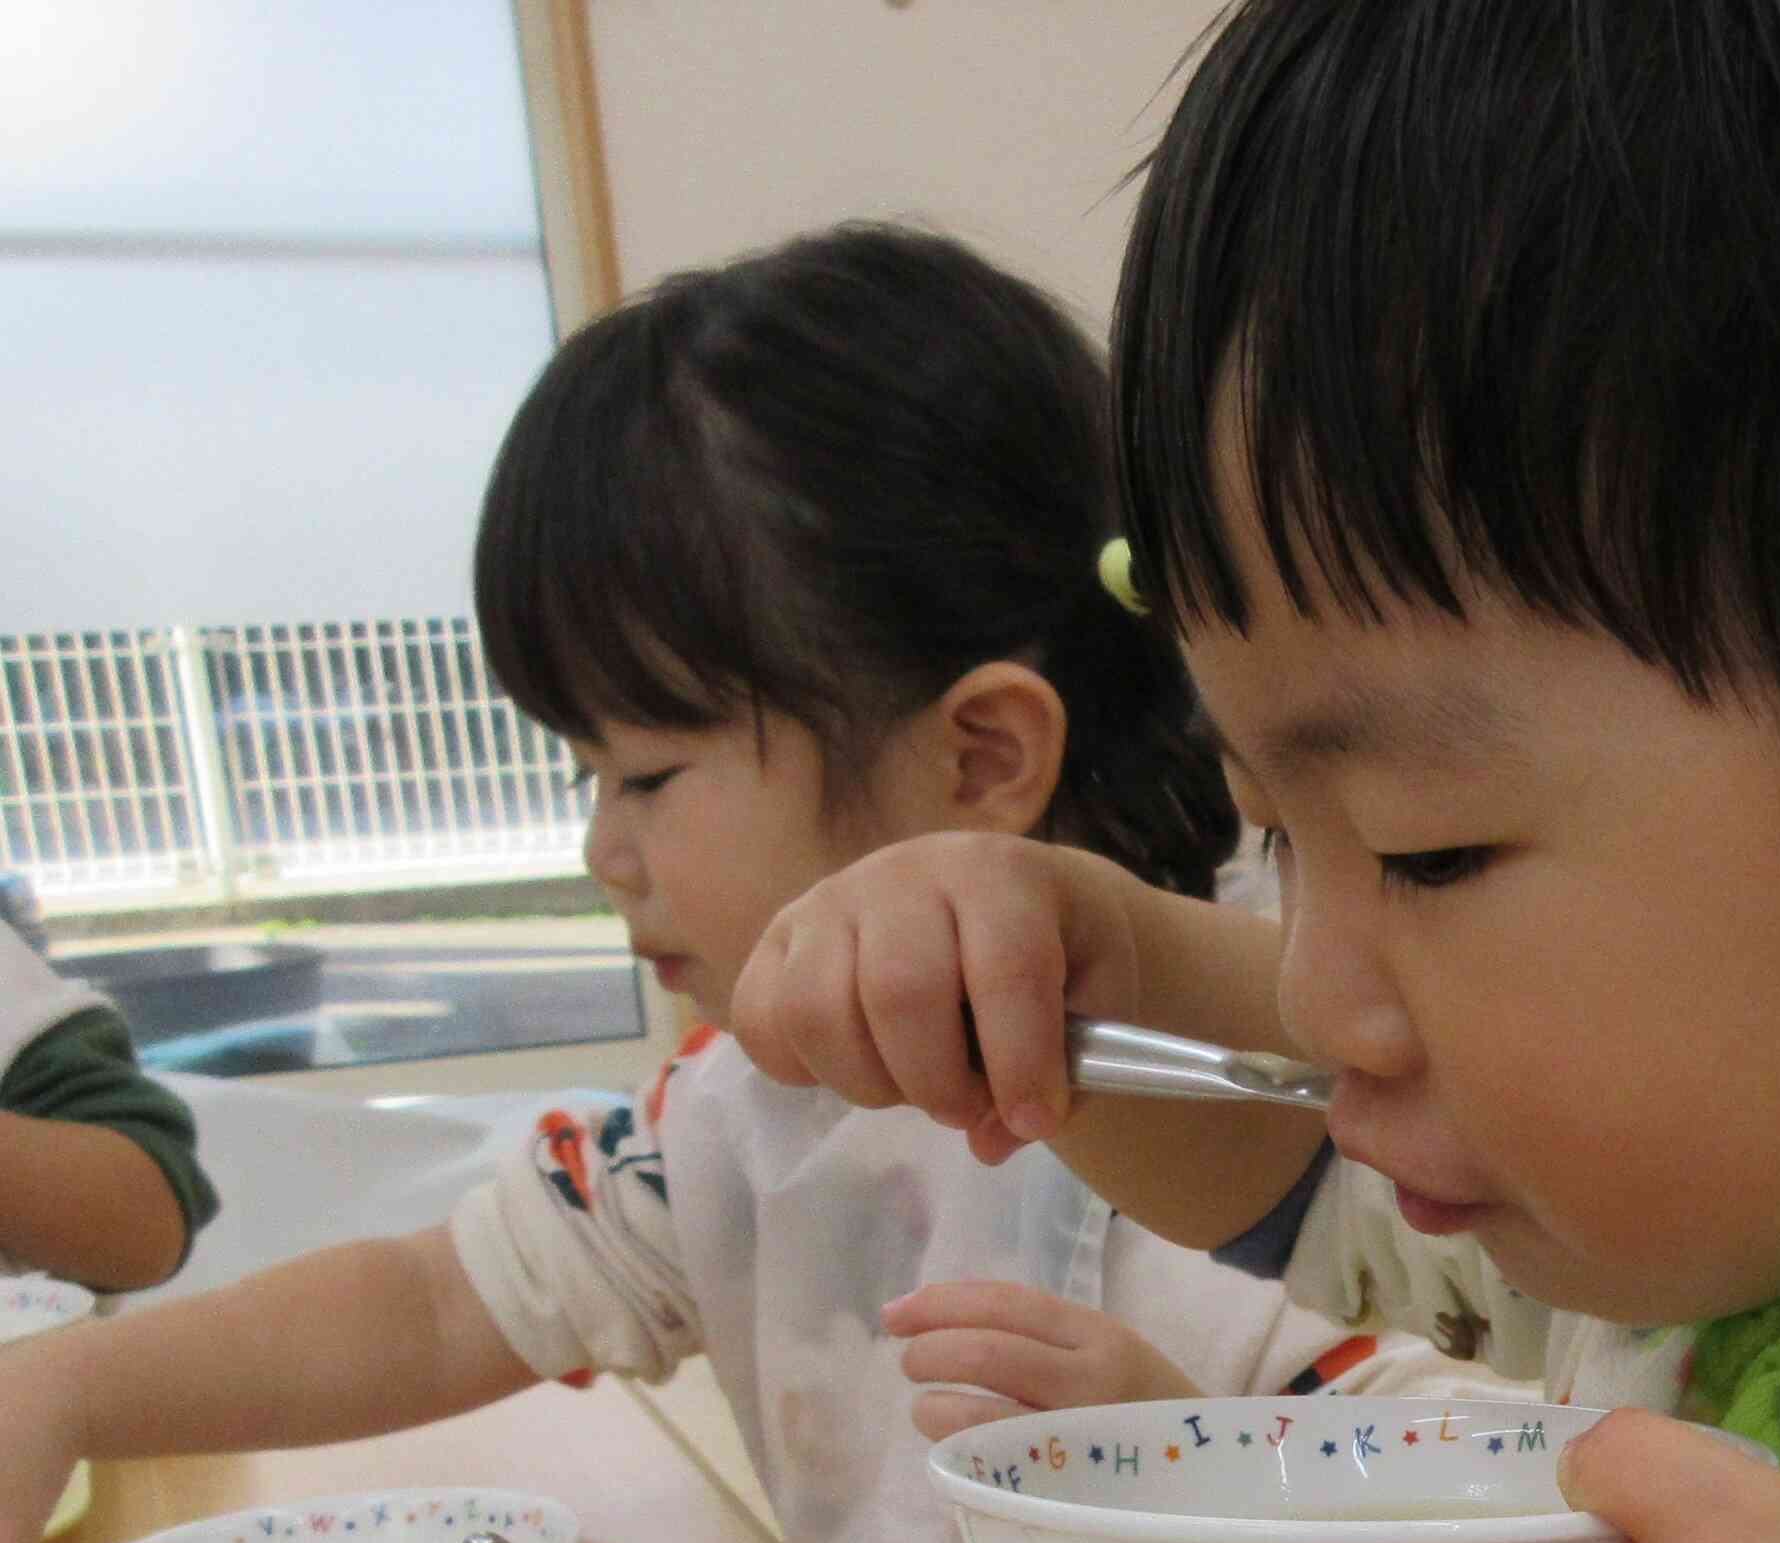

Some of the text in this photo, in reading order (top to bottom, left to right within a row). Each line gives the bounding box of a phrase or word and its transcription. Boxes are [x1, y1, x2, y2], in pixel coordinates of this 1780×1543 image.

[1048, 1435, 1067, 1472] G
[1115, 1442, 1140, 1477] H
[1184, 1415, 1210, 1448] I
[1267, 1416, 1294, 1448] J
[1355, 1424, 1381, 1459] K
[1440, 1411, 1458, 1441] L
[1517, 1421, 1546, 1452] M
[308, 1512, 335, 1533] W
